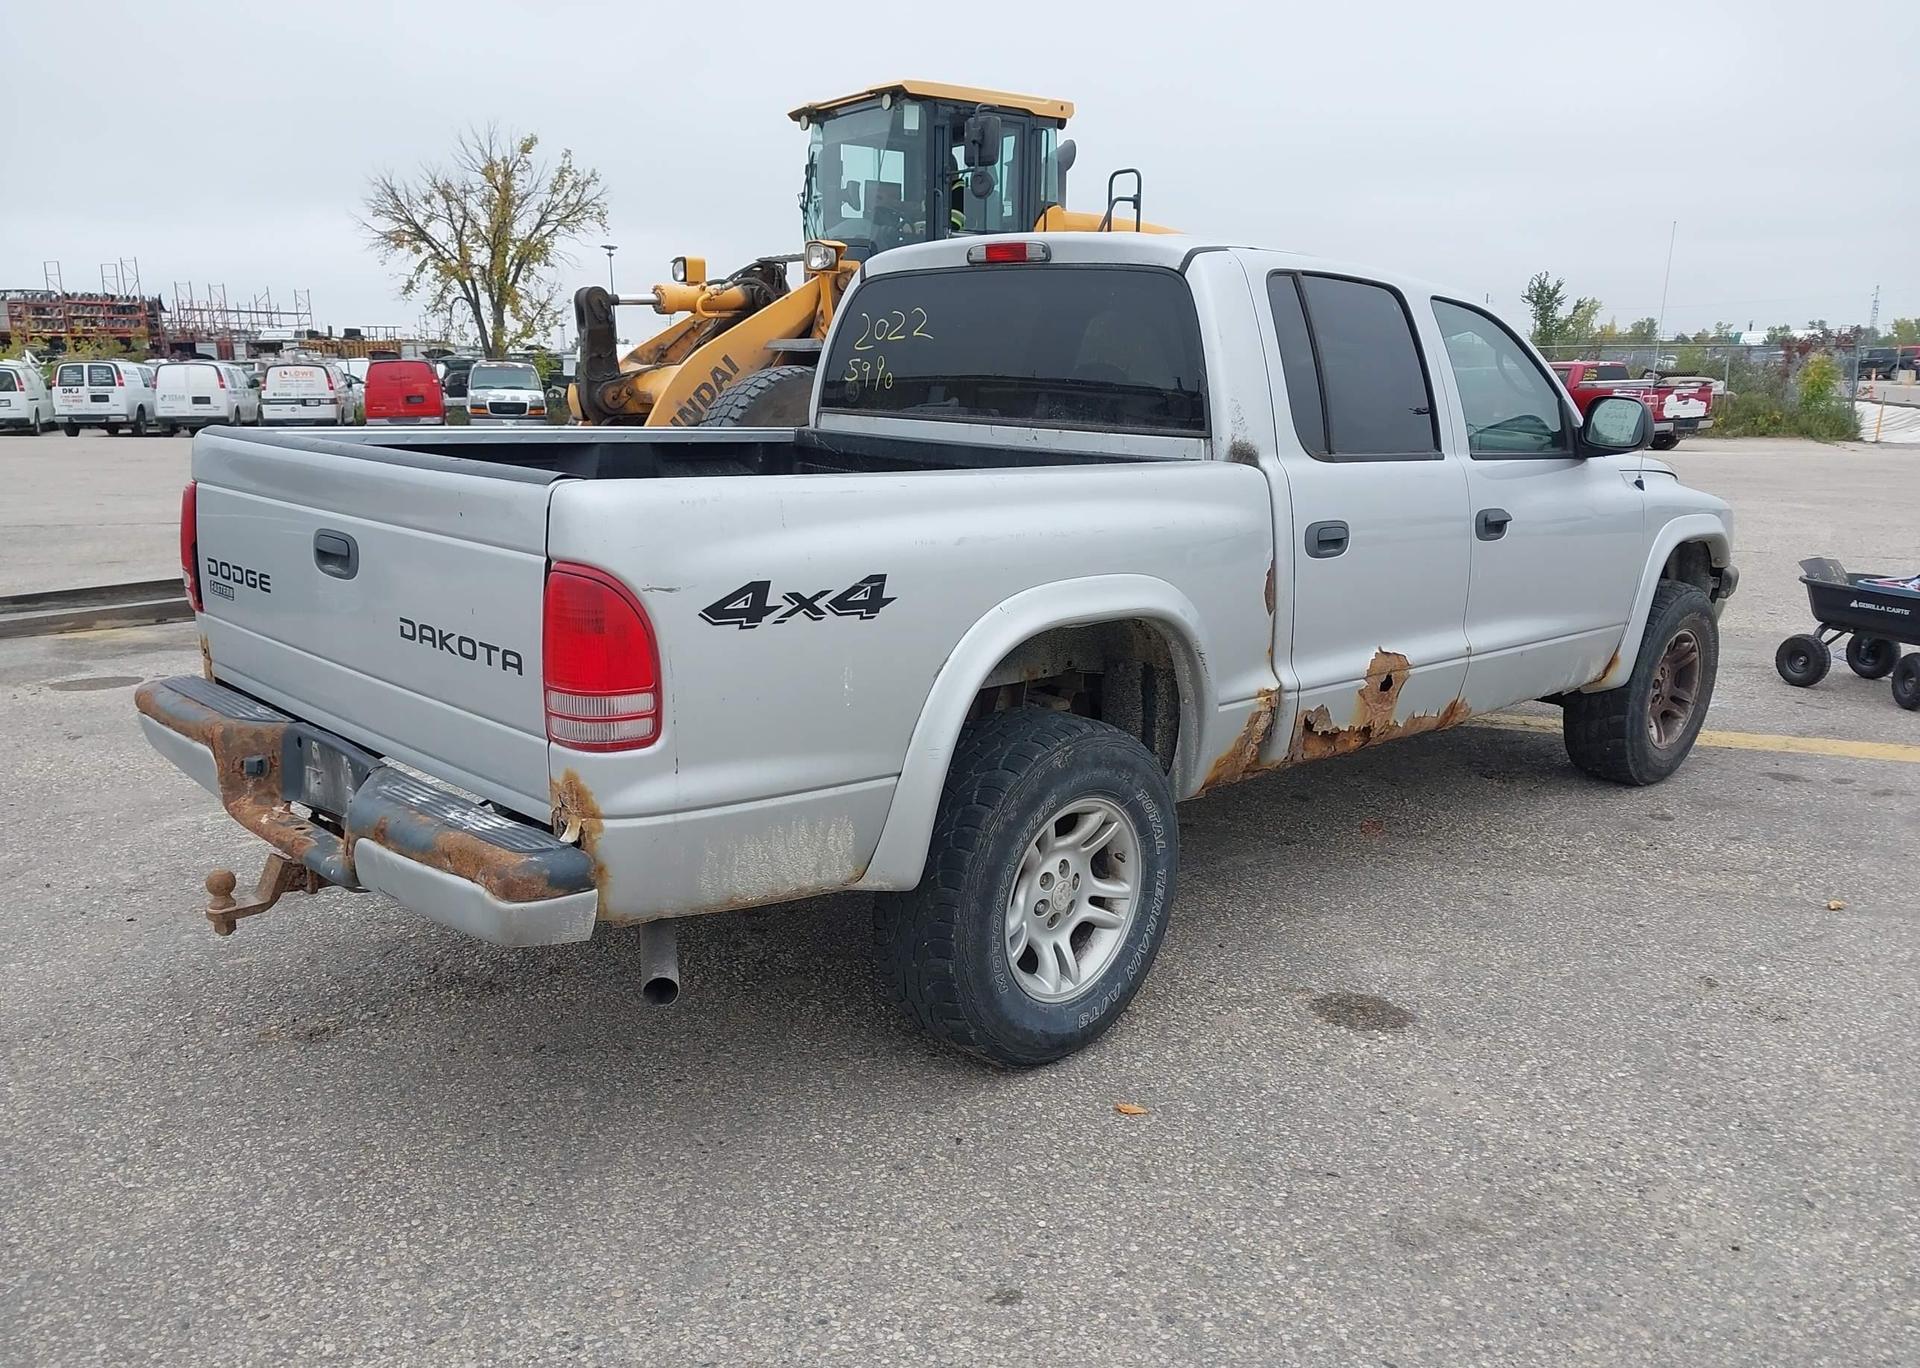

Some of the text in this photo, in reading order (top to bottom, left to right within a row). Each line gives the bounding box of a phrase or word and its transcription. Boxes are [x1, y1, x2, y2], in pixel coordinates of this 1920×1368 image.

[854, 307, 934, 351] 2022
[670, 354, 740, 426] NDAI
[207, 557, 271, 594] DODGE
[698, 573, 898, 630] 4x4
[1858, 601, 1910, 616] GORILLA CARTS
[399, 616, 523, 676] DAKOTA
[1136, 789, 1167, 855] TOTAL
[991, 794, 1058, 993] MOTOMASTER
[1126, 868, 1167, 982] TERRAIN
